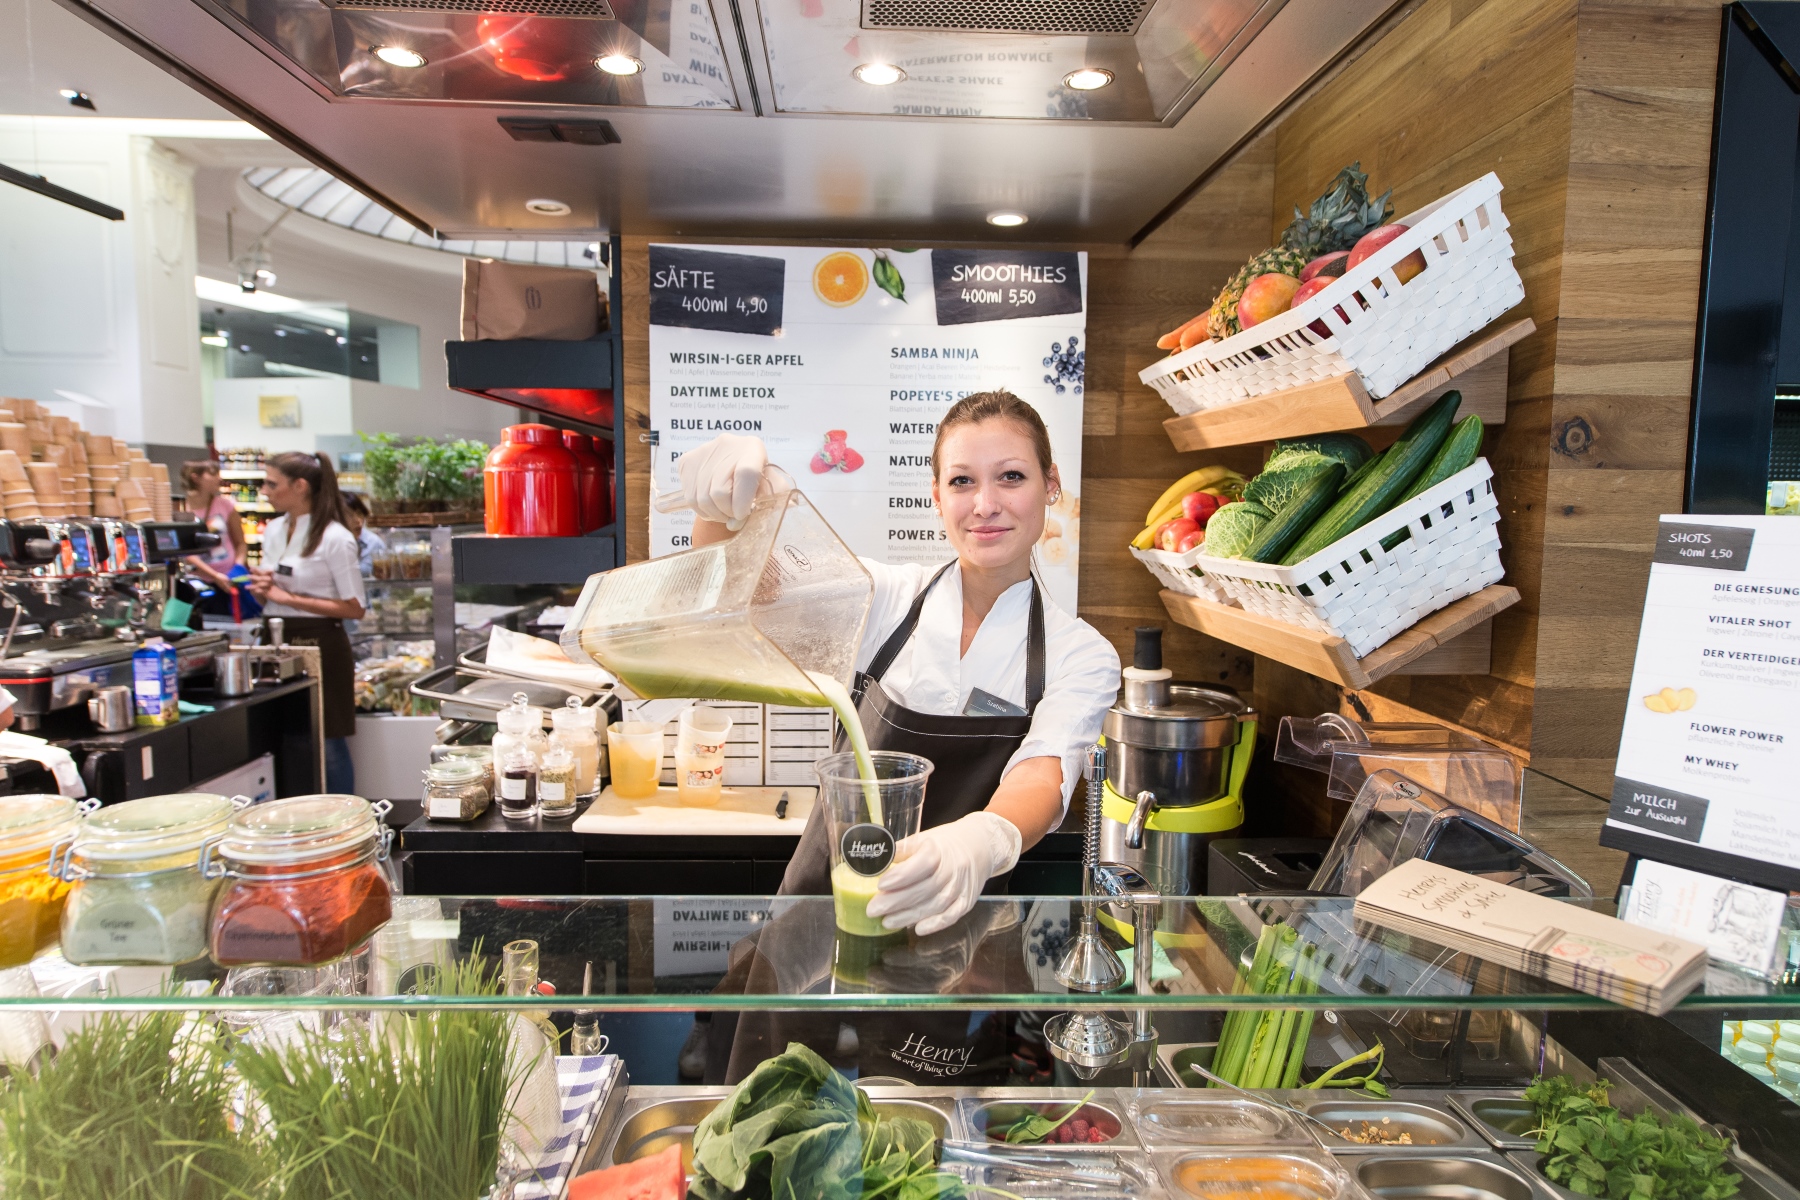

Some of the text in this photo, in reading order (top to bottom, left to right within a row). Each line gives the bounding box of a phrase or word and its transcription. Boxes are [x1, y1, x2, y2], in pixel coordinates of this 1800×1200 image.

[653, 265, 715, 289] SÄFTE
[951, 264, 1067, 283] SMOOTHIES
[961, 288, 1036, 307] 400ml 5,50
[682, 296, 768, 316] 400ml 4,90
[670, 352, 804, 366] WIRSIN-I-GER APFEL
[890, 347, 979, 361] SAMBA NINJA
[688, 369, 705, 377] Apfel
[709, 369, 756, 377] Wassermelone
[890, 363, 916, 371] Orangen
[670, 386, 775, 398] DAYTIME DETOX
[890, 390, 953, 401] POPEYE'S
[768, 403, 790, 411] Ingwer
[670, 419, 762, 431] BLUE LAGOON
[889, 456, 932, 466] NATUR
[889, 497, 932, 508] ERDNU
[888, 529, 935, 540] POWER
[1668, 532, 1712, 544] SHOTS
[1679, 548, 1733, 559] 40ml 1,50
[1714, 583, 1800, 596] DIE GENESUNG
[1712, 595, 1756, 605] Apfelessig
[1709, 615, 1792, 629] VITALER SHOT
[1706, 626, 1735, 636] Ingwer
[1742, 629, 1773, 638] Zitrone
[1703, 648, 1800, 665] DER VERTEIDIGE
[1700, 660, 1800, 677] Kurkumapulver Ingwe
[1737, 674, 1750, 682] mit
[1753, 675, 1792, 687] Oregano
[1690, 722, 1784, 743] FLOWER POWER
[1737, 740, 1775, 753] Proteine
[1684, 755, 1739, 771] MY WHEY
[1682, 765, 1751, 784] Molkenproteine
[1633, 792, 1677, 811] MILCH
[1646, 808, 1688, 826] Auswahl
[851, 840, 886, 857] Henry
[900, 1032, 975, 1075] Henry
